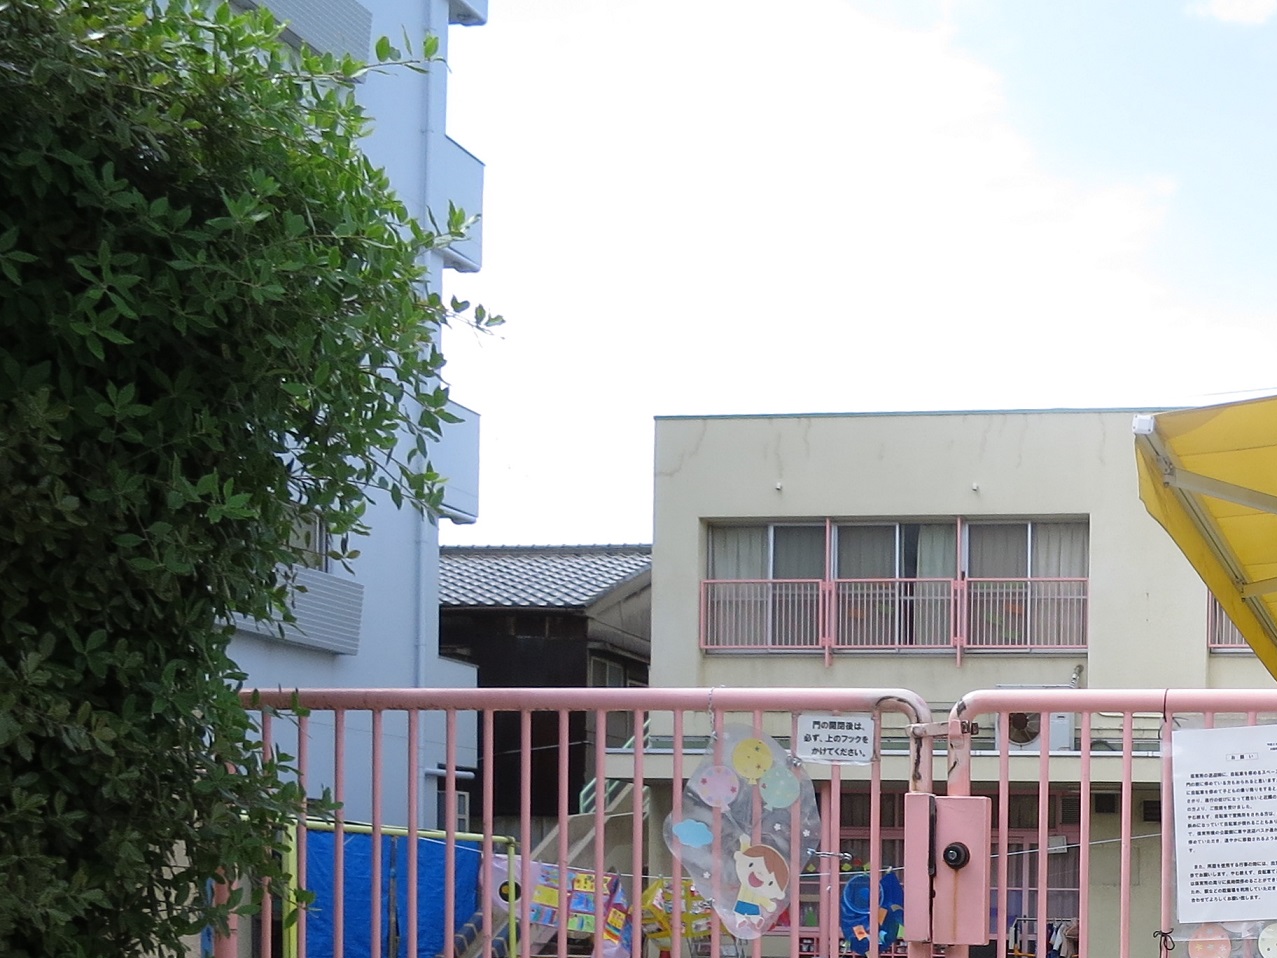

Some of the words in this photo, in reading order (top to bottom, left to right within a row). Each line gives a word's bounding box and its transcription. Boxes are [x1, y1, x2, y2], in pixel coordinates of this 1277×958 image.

[812, 720, 865, 731] 門の開閉後は、
[804, 734, 869, 743] 必ず、上のフックを
[811, 747, 866, 757] かけてください。
